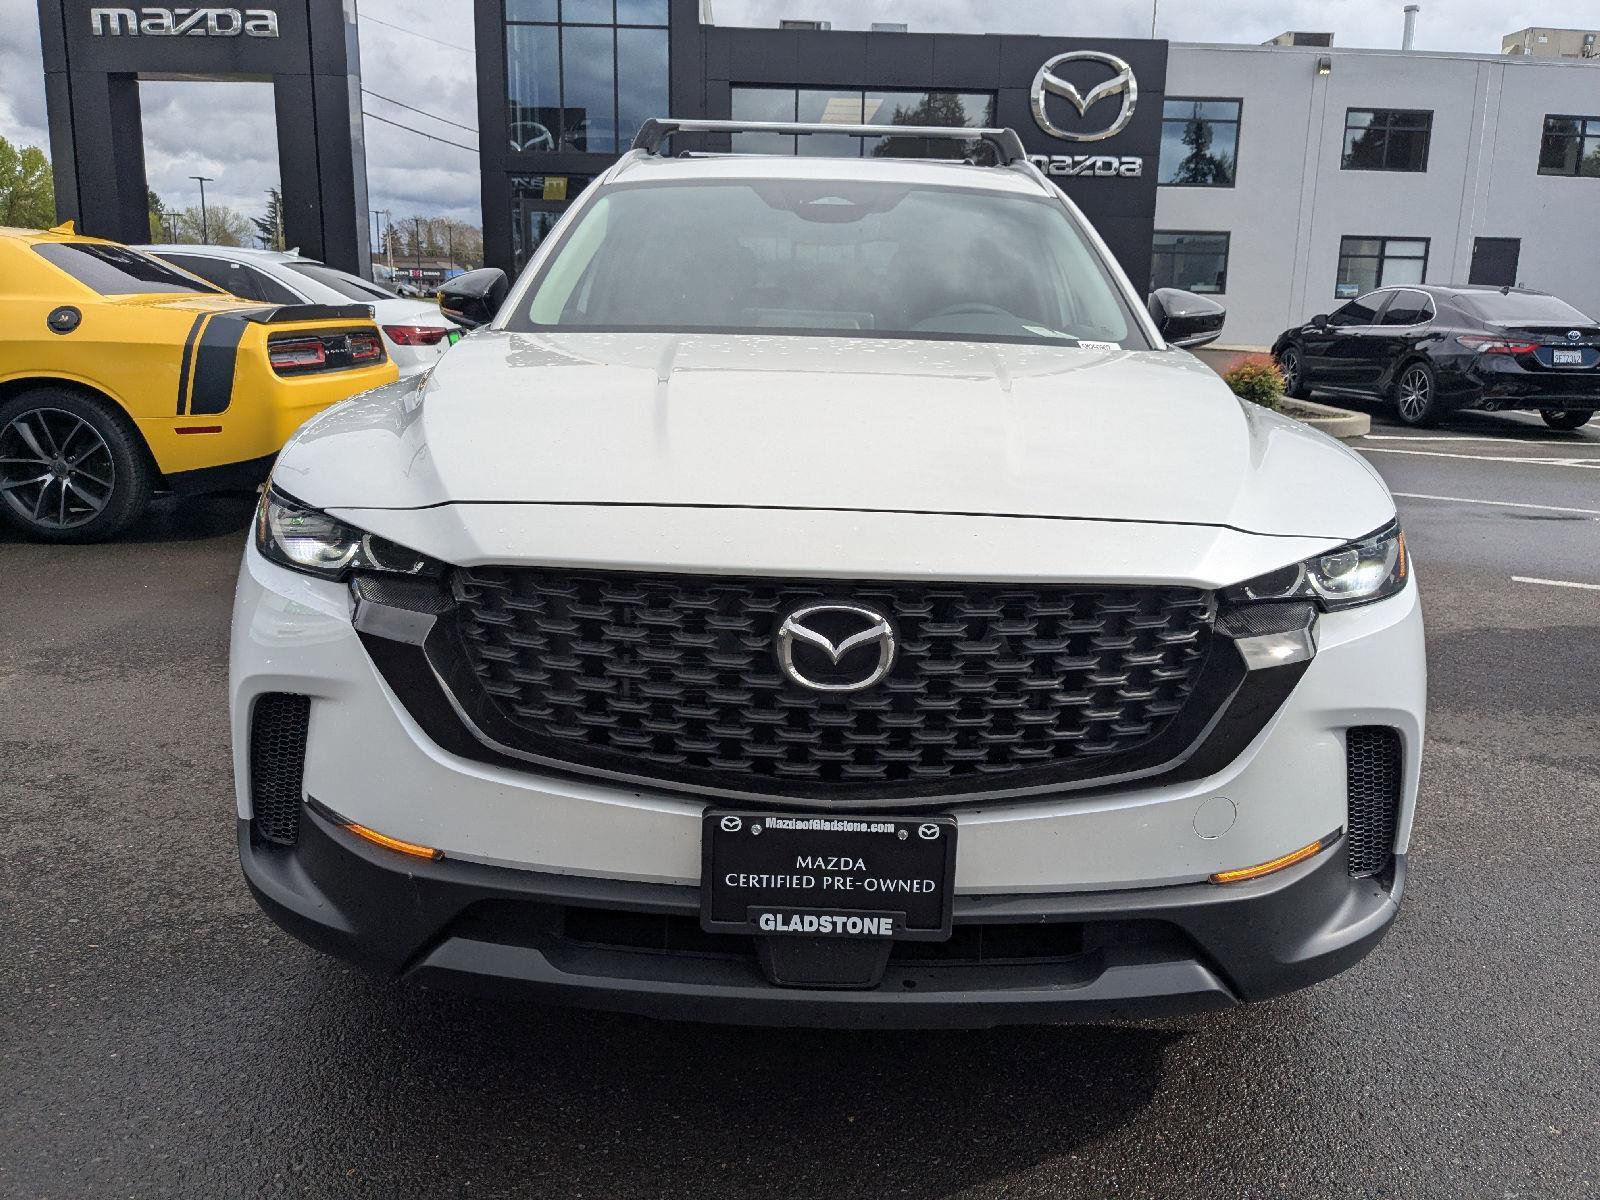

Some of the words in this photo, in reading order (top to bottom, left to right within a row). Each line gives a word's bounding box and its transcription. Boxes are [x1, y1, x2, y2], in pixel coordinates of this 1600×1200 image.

[765, 817, 895, 833] MazdaofGladstone.com
[796, 855, 866, 871] MAZDA
[725, 873, 815, 889] CERTIFIED
[823, 876, 936, 893] PRE-OWNED
[759, 913, 892, 935] GLADSTONE
